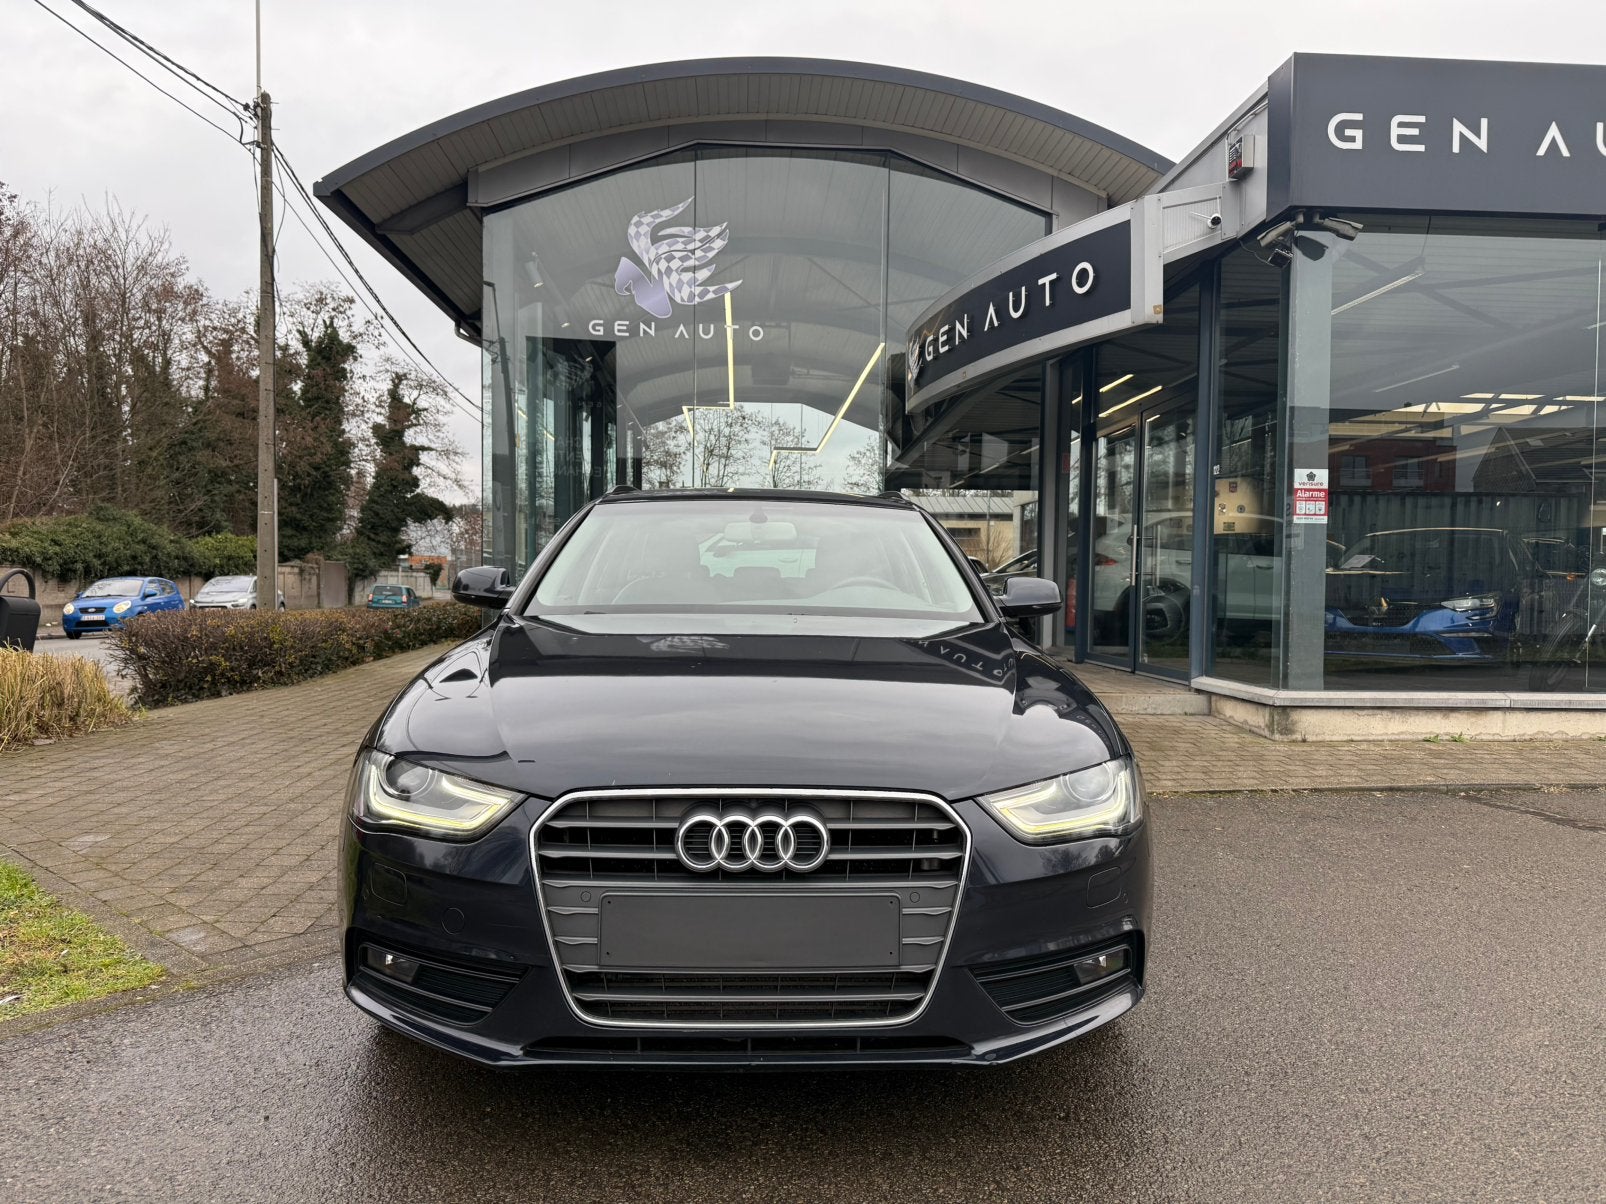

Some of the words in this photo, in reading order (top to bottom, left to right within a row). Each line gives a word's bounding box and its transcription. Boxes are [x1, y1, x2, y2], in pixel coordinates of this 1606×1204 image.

[1327, 112, 1489, 154] GEN
[925, 313, 968, 362] GEN
[984, 261, 1095, 332] AUTO
[588, 319, 656, 337] GEN
[674, 323, 764, 341] AUTO
[1296, 489, 1326, 498] Alarme
